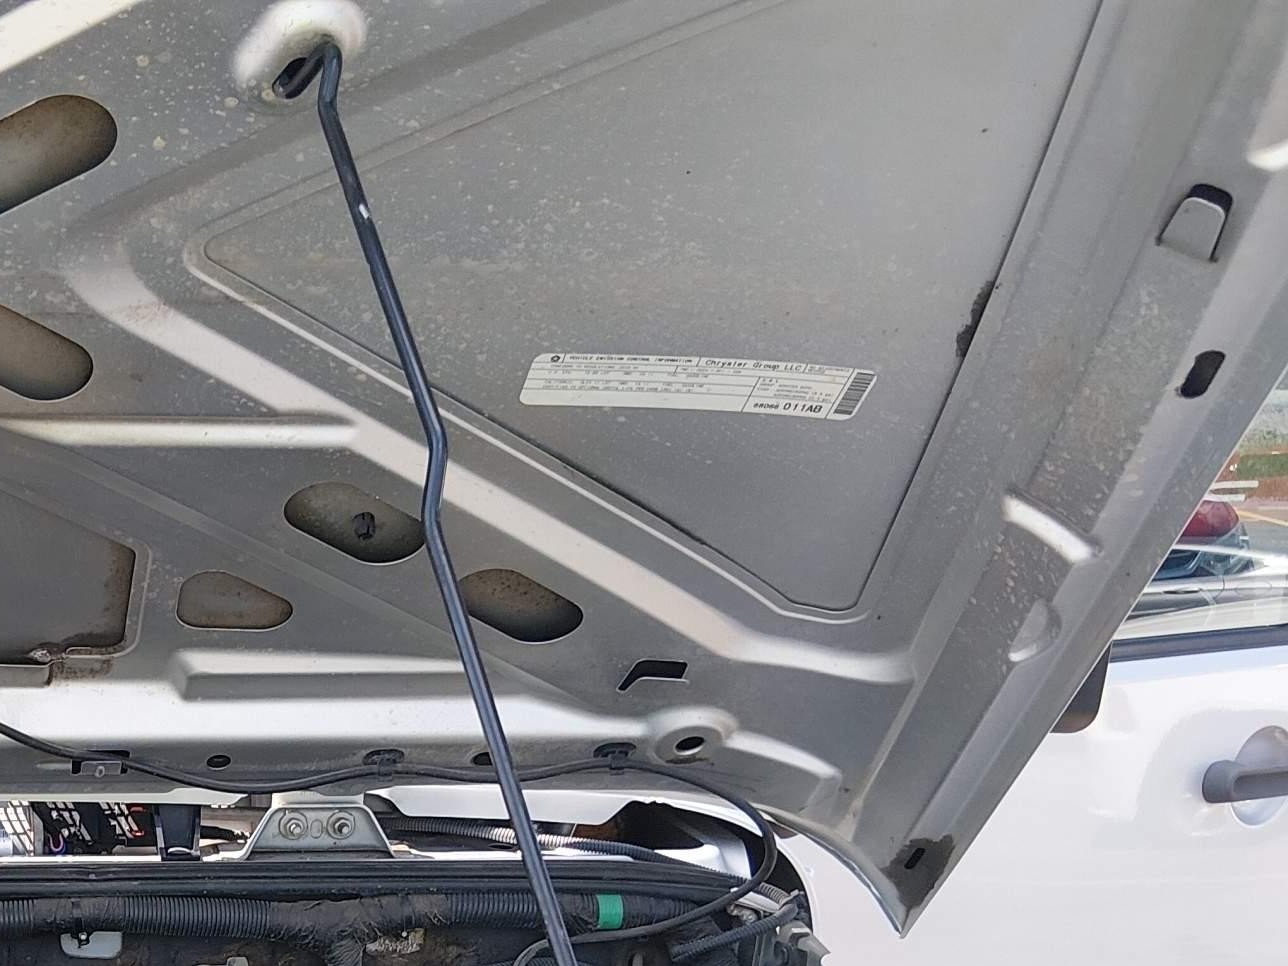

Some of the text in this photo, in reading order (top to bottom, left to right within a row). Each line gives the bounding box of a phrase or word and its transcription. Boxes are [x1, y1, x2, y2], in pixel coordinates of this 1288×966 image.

[705, 359, 748, 369] Chrysler
[753, 361, 780, 371] Group
[784, 363, 802, 372] LLC
